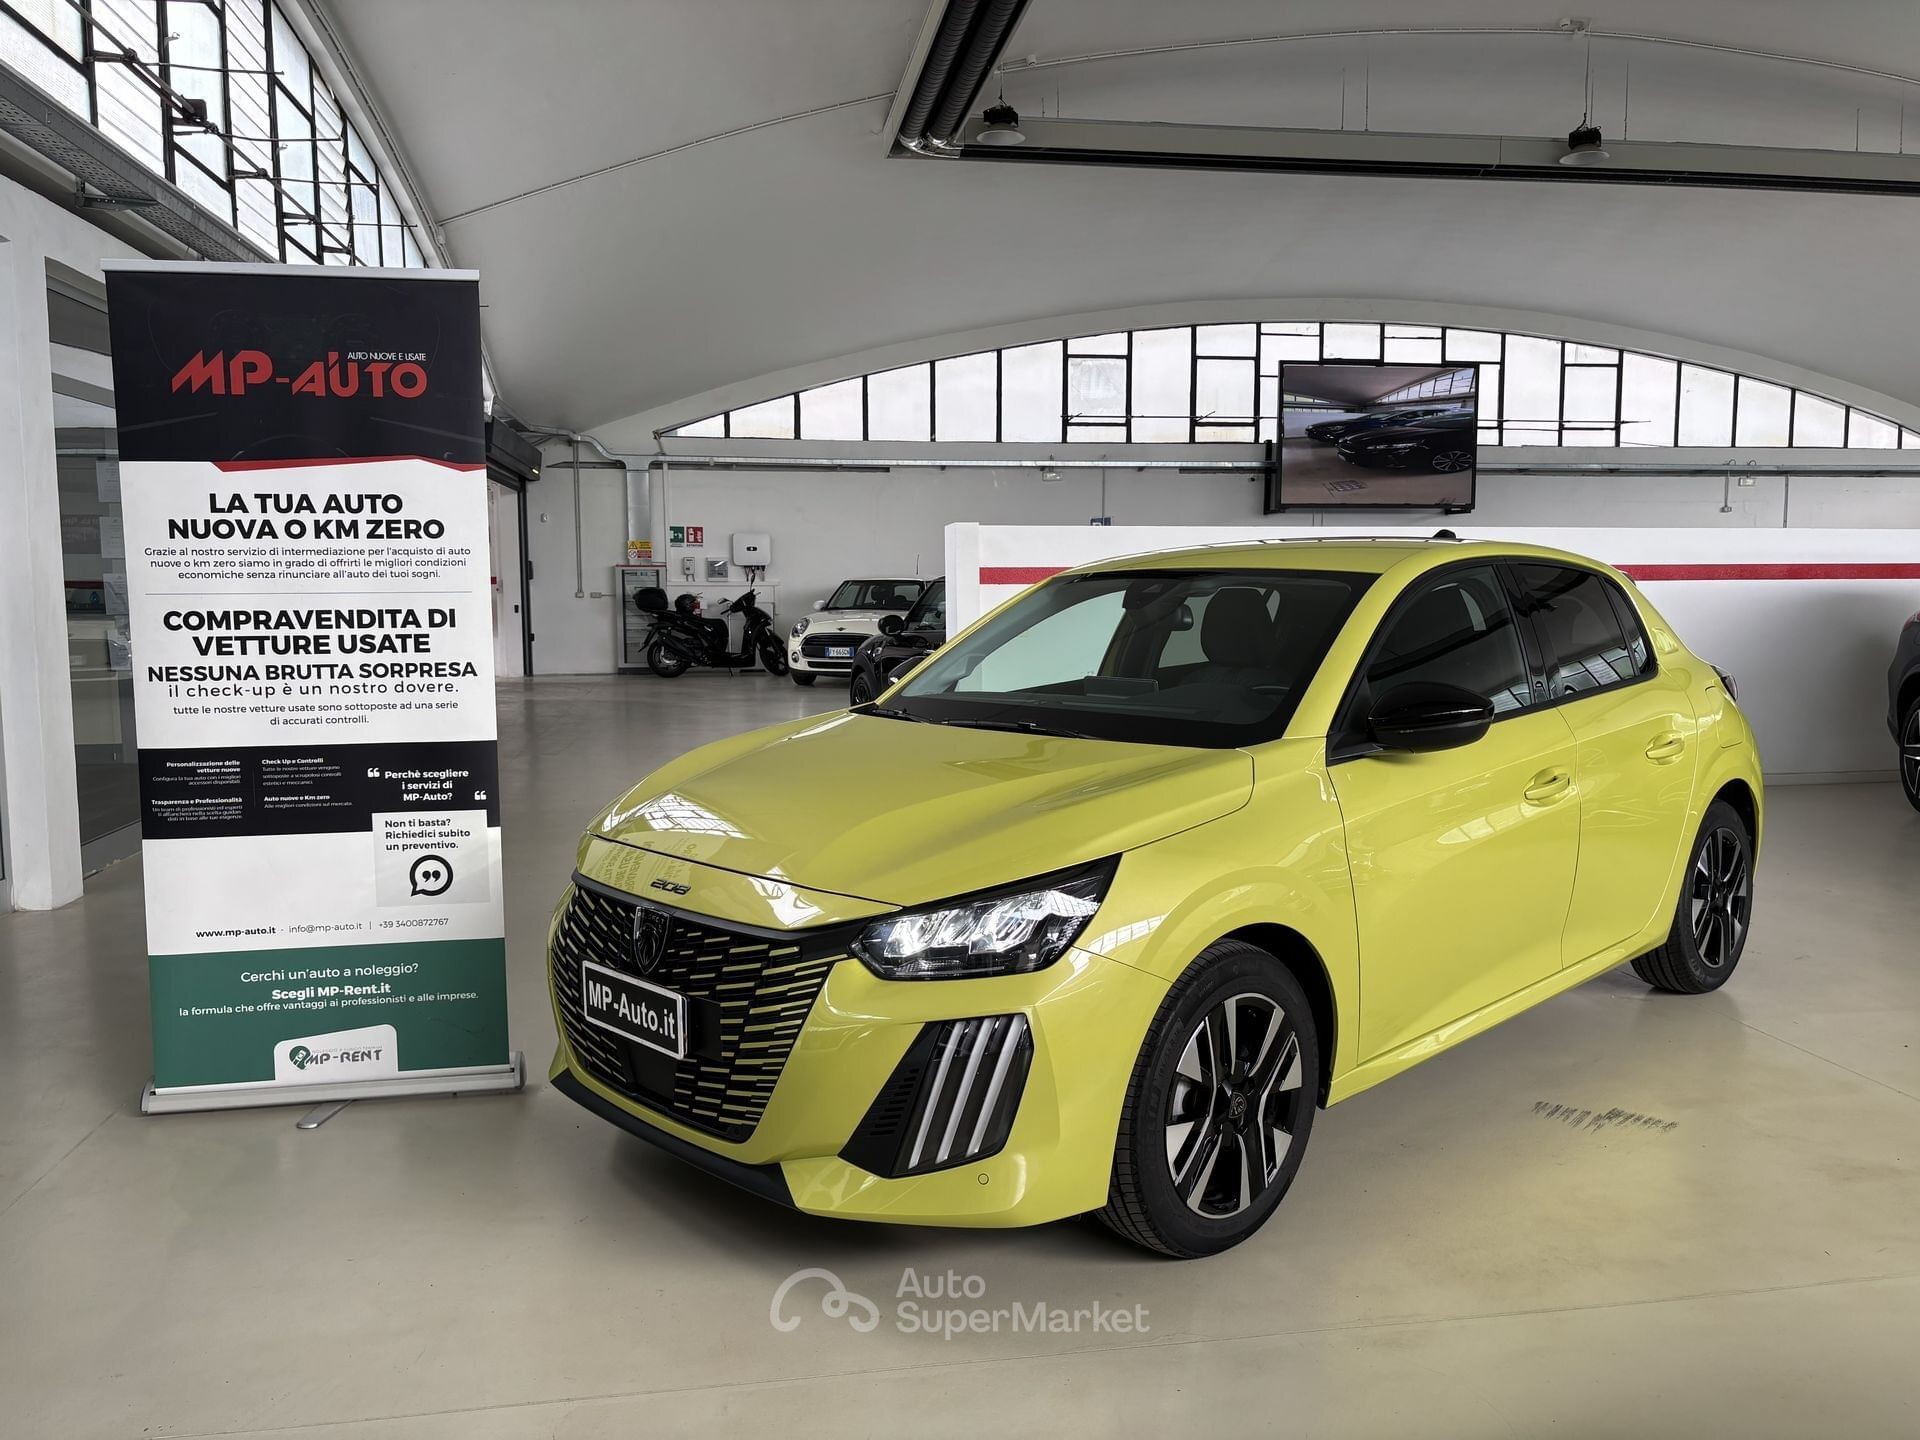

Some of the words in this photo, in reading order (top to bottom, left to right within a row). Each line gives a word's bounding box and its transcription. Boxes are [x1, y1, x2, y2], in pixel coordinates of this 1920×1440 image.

[348, 352, 368, 360] AUTO
[370, 352, 397, 360] NUOVE
[405, 353, 426, 361] USATE
[171, 350, 427, 398] MP-AUTO
[210, 493, 249, 514] LA
[254, 494, 317, 514] TUA
[322, 494, 403, 514] AUTO
[168, 519, 278, 539] NUOVA
[284, 519, 306, 539] O
[314, 519, 359, 539] KM
[366, 519, 445, 539] ZERO
[144, 548, 176, 556] Grazie
[179, 548, 188, 556] al
[192, 548, 224, 556] nostro
[228, 548, 266, 556] servizio
[269, 548, 278, 556] di
[282, 548, 365, 556] intermediazione
[368, 549, 384, 557] per
[387, 547, 433, 557] l'acquisto
[436, 547, 445, 555] di
[194, 559, 210, 567] km
[239, 559, 270, 567] siamo
[273, 559, 282, 567] in
[285, 559, 314, 568] grado
[318, 559, 327, 567] di
[330, 558, 360, 567] offrirti
[364, 558, 372, 566] le
[375, 558, 412, 568] migliori
[415, 558, 466, 566] condizioni
[178, 570, 244, 579] economiche
[279, 570, 330, 578] rinunciare
[333, 570, 369, 578] all'auto
[372, 570, 387, 578] dei
[390, 570, 409, 578] tuoi
[412, 570, 440, 579] sogni.
[163, 609, 422, 631] COMPRAVENDITA
[428, 609, 456, 628] DI
[192, 635, 331, 656] VETTURE
[338, 634, 430, 654] USATE
[148, 665, 260, 682] NESSUNA
[266, 664, 354, 680] BRUTTA
[359, 662, 478, 678] SORPRESA
[168, 685, 178, 697] il
[186, 684, 275, 698] check-up
[283, 683, 292, 695] è
[300, 685, 321, 694] un
[330, 683, 387, 694] nostro
[395, 681, 458, 693] dovere.
[174, 706, 199, 714] tutte
[345, 702, 397, 712] sottoposte
[270, 717, 280, 725] di
[283, 716, 323, 724] accurati
[326, 715, 369, 724] controlli.
[385, 770, 420, 779] Perchè
[423, 769, 469, 779] scegliere
[408, 781, 440, 789] servizi
[404, 793, 453, 801] MP-Auto?
[408, 819, 415, 827] ti
[385, 830, 436, 839] Richiedici
[438, 829, 470, 837] subito
[402, 841, 458, 851] preventivo.
[651, 879, 691, 895] 208
[196, 926, 276, 938] www.mp-auto.it
[288, 923, 362, 933] info@mp-auto.it
[379, 921, 393, 929] +39
[396, 918, 448, 928] 3400872767
[241, 970, 284, 982] Cerchi
[288, 968, 340, 979] un'auto
[355, 963, 419, 976] noleggio?
[272, 986, 314, 1000] Scegli
[318, 983, 391, 996] MP-Rent.it
[180, 1008, 188, 1016] la
[192, 1006, 232, 1015] formula
[235, 1004, 254, 1012] che
[257, 1002, 280, 1011] offre
[283, 999, 326, 1010] vantaggi
[330, 998, 338, 1007] ai
[341, 995, 406, 1008] professionisti
[417, 993, 434, 1001] alle
[437, 992, 478, 1001] imprese.
[588, 980, 676, 1039] MP-Auto.it
[306, 1050, 382, 1065] MP-RENT
